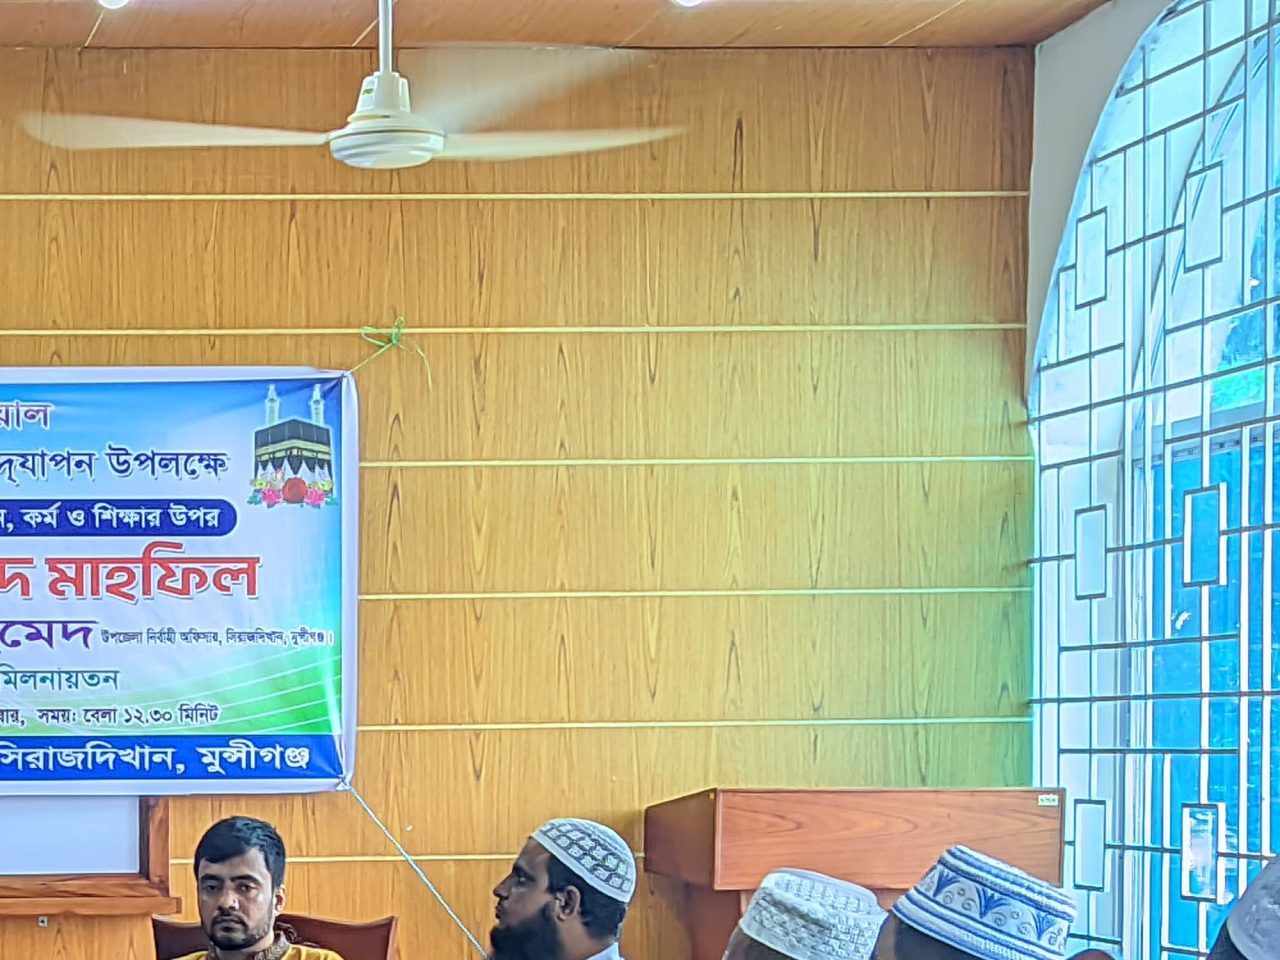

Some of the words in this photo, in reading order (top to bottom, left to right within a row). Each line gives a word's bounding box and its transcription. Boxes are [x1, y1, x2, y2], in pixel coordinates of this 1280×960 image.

[106, 444, 229, 480] উপলক্ষে
[21, 502, 59, 529] কর্ম
[66, 509, 85, 529] ও
[92, 502, 161, 529] শিক্ষার
[168, 503, 221, 529] উপর
[45, 541, 260, 603] মাহফিল
[83, 708, 118, 724] বেলা
[178, 703, 220, 724] মিনিট
